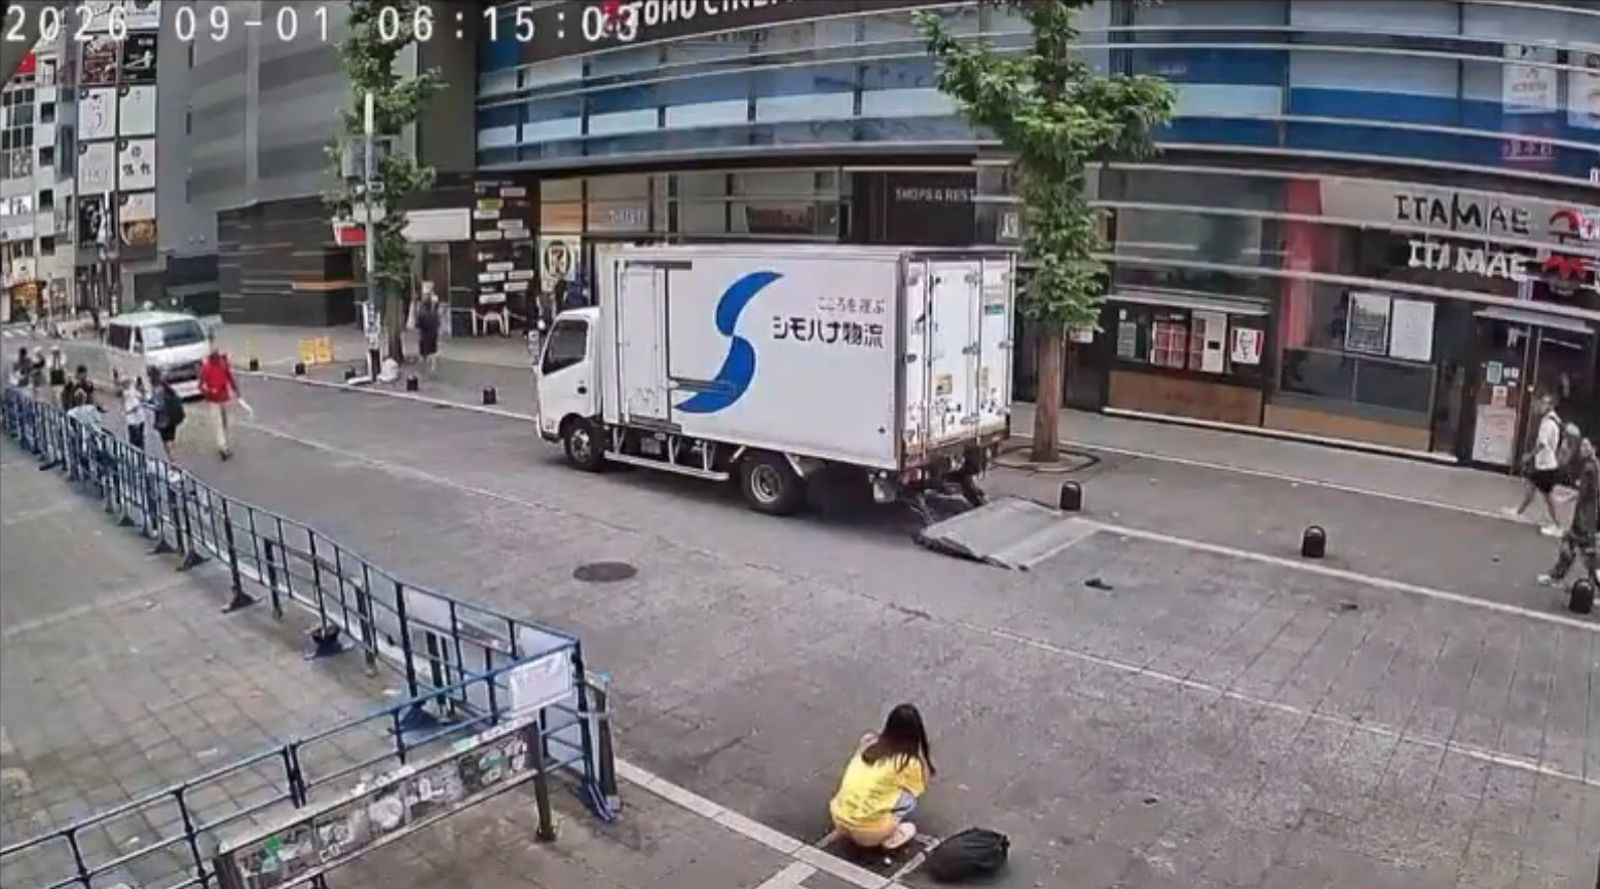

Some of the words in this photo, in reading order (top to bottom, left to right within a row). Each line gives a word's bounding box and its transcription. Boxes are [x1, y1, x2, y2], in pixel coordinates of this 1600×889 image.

[1394, 193, 1529, 235] ITAMAE
[772, 315, 884, 349] シモハナ物流
